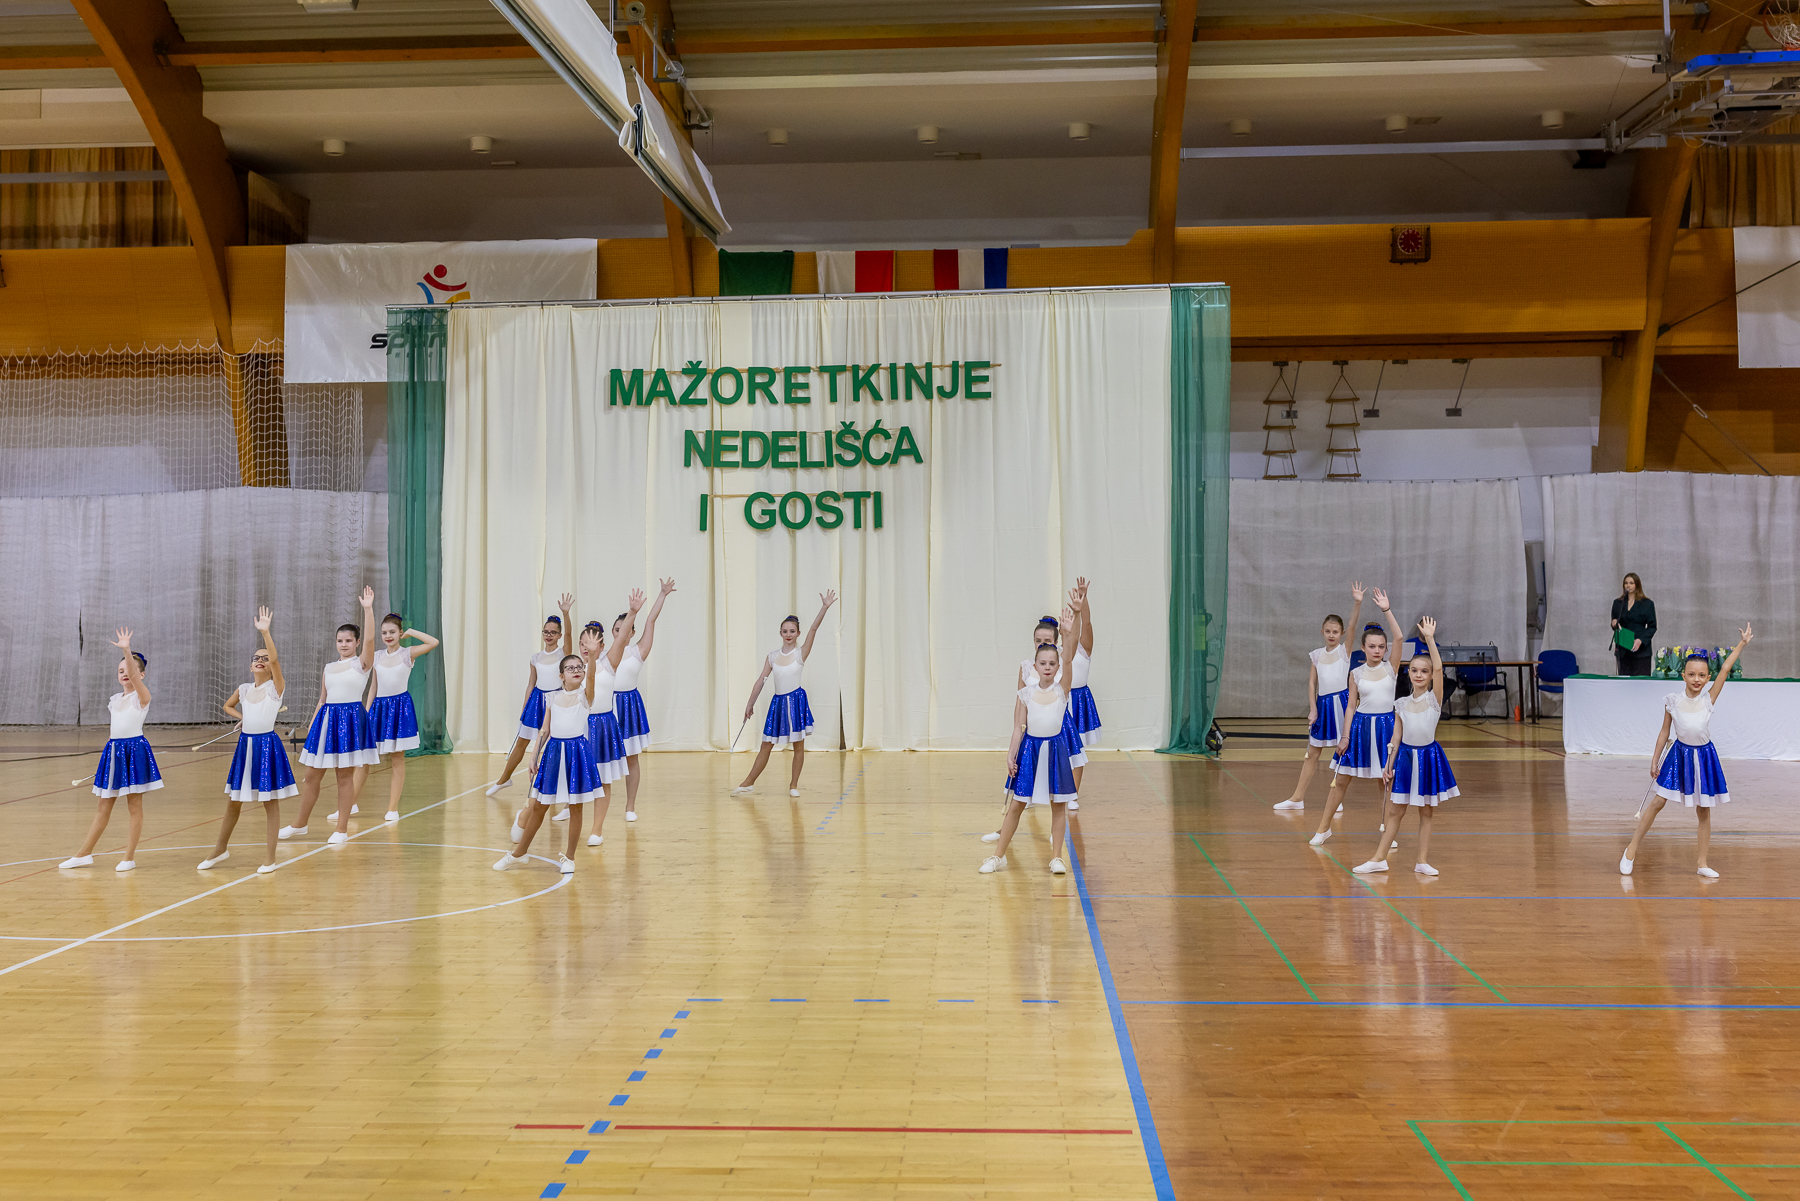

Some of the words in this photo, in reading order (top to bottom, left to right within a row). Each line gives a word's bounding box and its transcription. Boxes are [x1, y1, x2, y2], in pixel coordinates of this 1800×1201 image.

[609, 360, 992, 406] MAŽORETKINJE
[684, 419, 924, 468] NEDELIŠĆA
[699, 493, 709, 531] I
[744, 491, 883, 530] GOSTI
